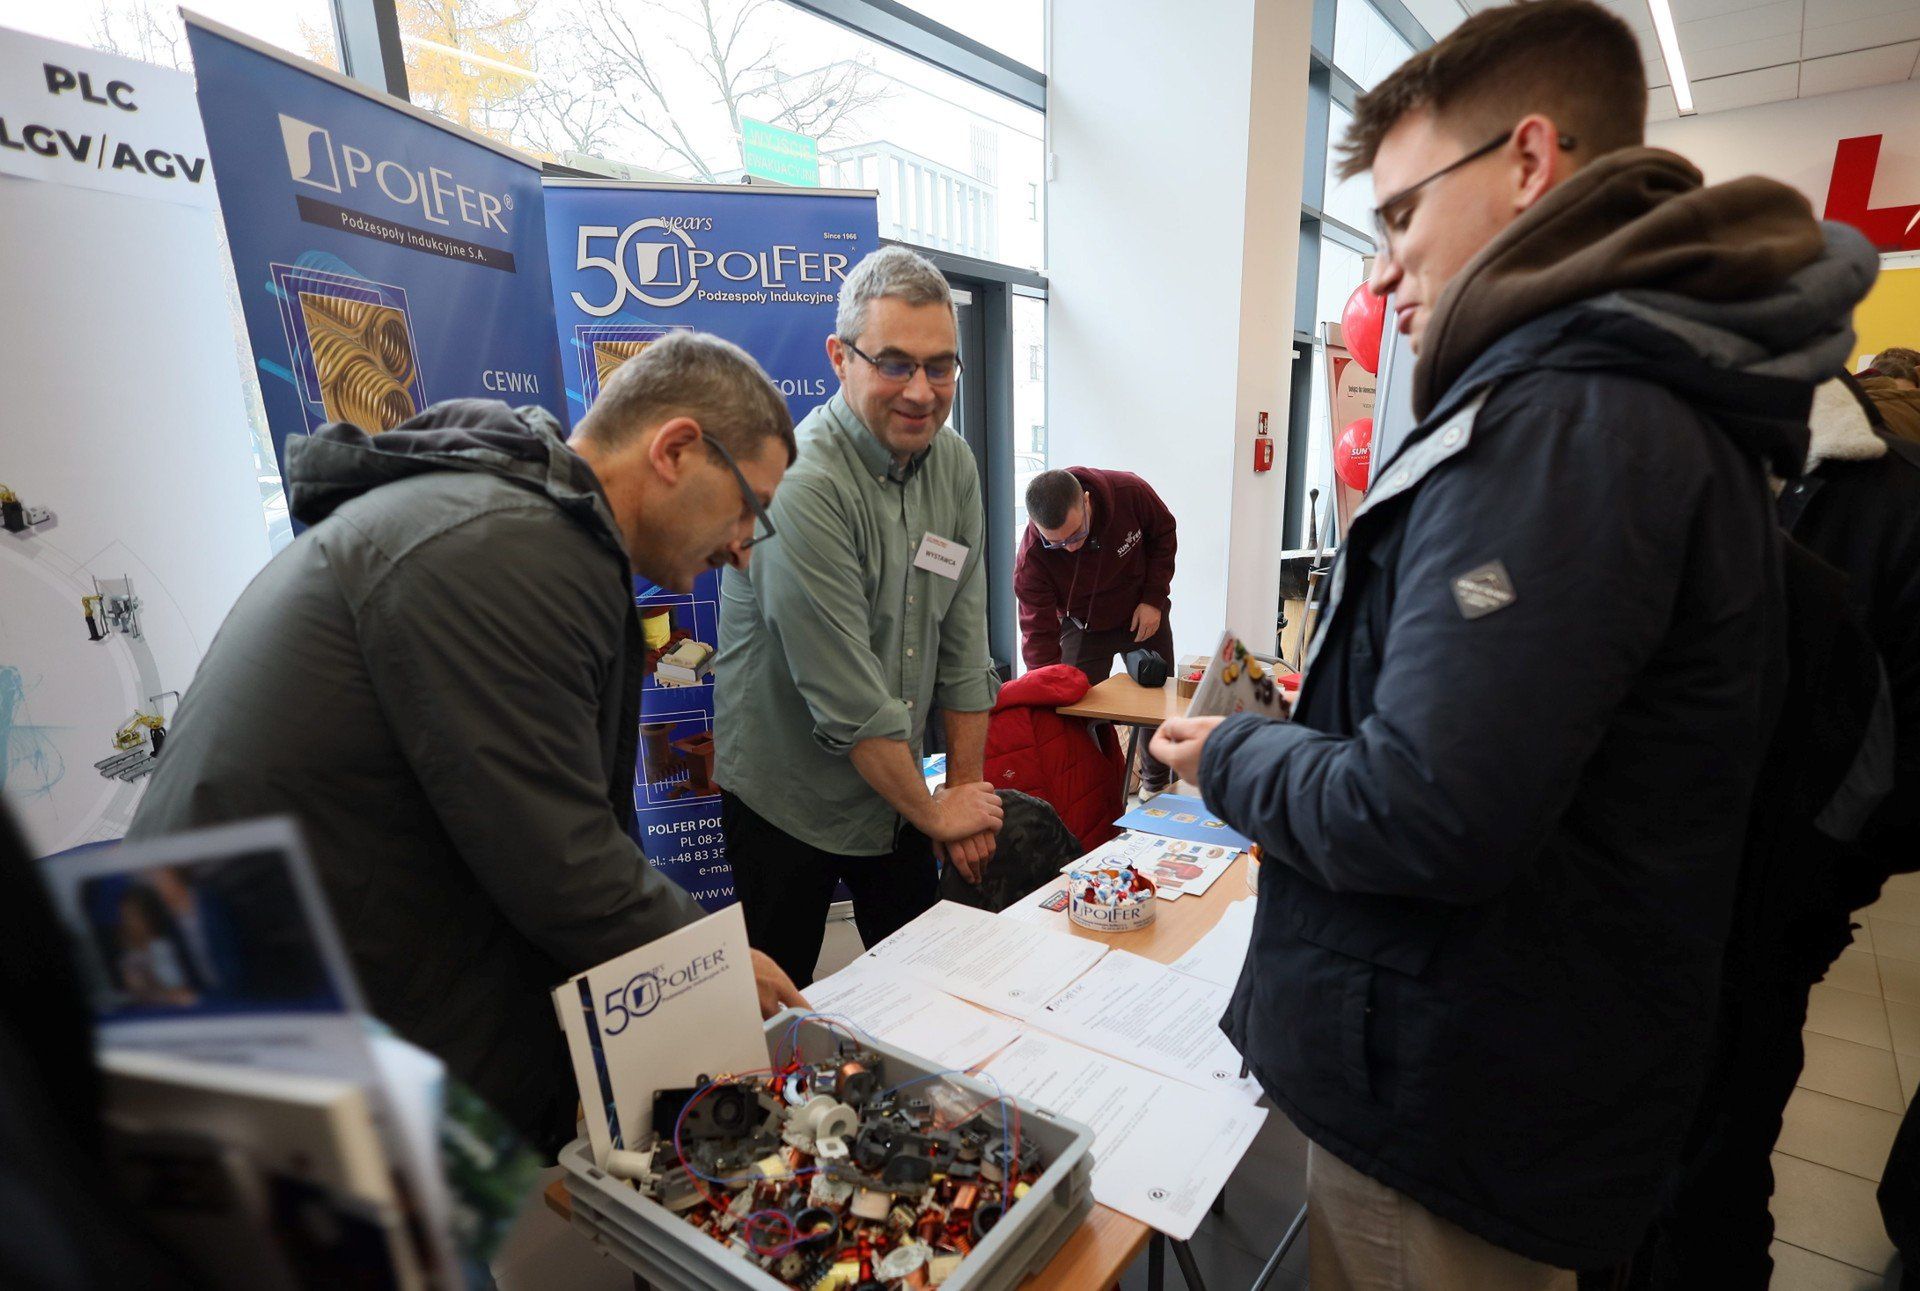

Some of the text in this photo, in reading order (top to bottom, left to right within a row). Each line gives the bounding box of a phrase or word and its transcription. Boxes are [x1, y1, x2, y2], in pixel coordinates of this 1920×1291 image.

[43, 63, 138, 112] PLC
[660, 216, 712, 235] years
[341, 212, 487, 261] Podzespoły Indukcyjne S.A.
[823, 232, 841, 240] Since
[698, 289, 767, 304] Podzespoły
[770, 290, 834, 304] Indukcyjne
[482, 370, 539, 394] CEWKI
[647, 820, 696, 836] POLFER
[680, 836, 695, 847] PL
[649, 855, 666, 867] el.:
[668, 852, 692, 864] +48
[694, 850, 709, 861] 83
[1084, 906, 1140, 922] POLFER
